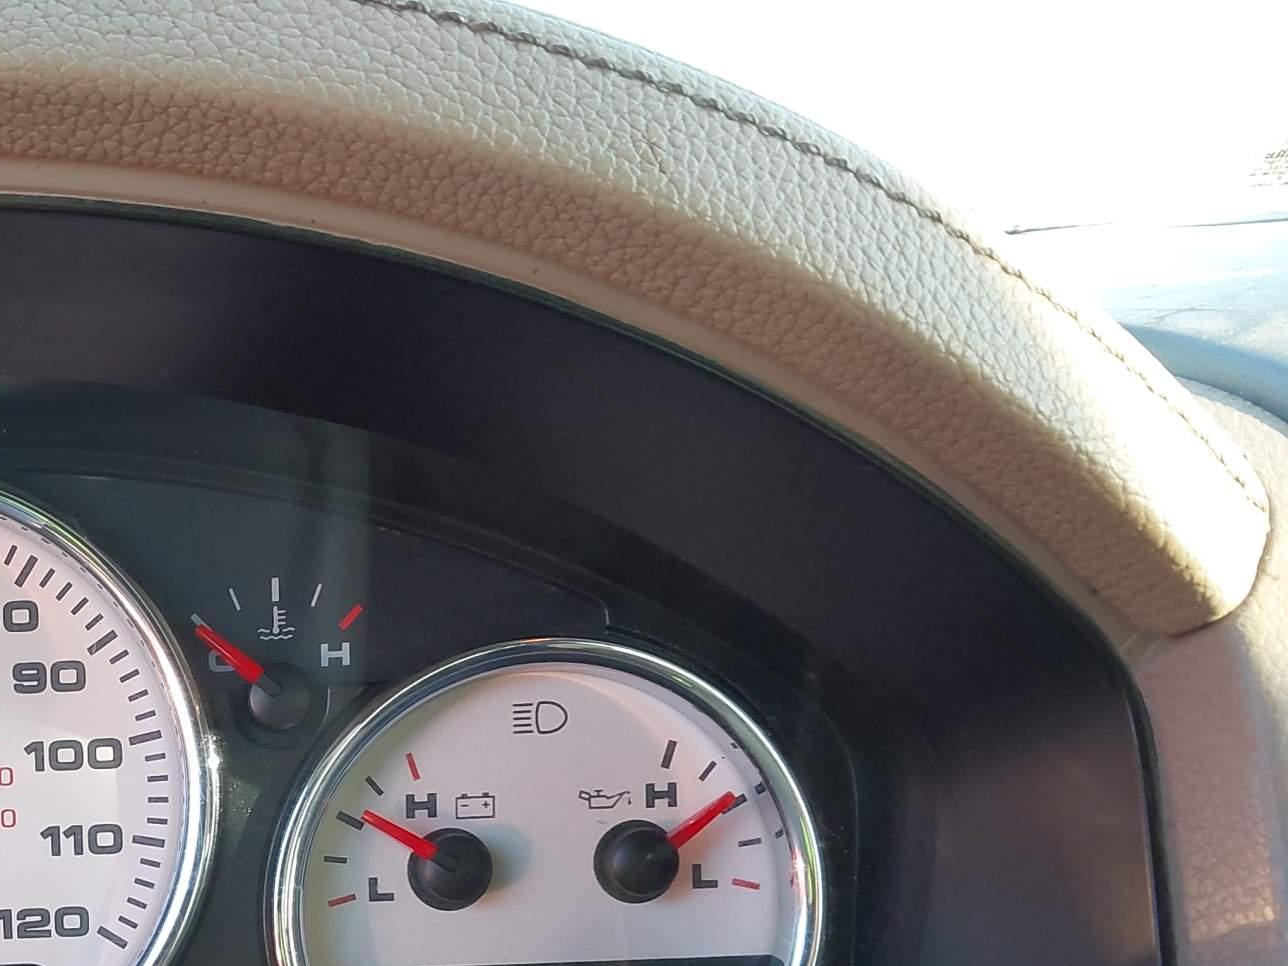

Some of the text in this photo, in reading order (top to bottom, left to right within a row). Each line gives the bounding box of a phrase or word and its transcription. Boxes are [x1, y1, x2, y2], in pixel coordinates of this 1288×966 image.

[321, 642, 351, 667] H
[12, 660, 86, 694] 90
[24, 738, 123, 772] 100
[405, 793, 437, 818] H
[645, 782, 677, 808] H
[40, 823, 124, 857] 110
[692, 864, 718, 889] L
[368, 877, 394, 902] L
